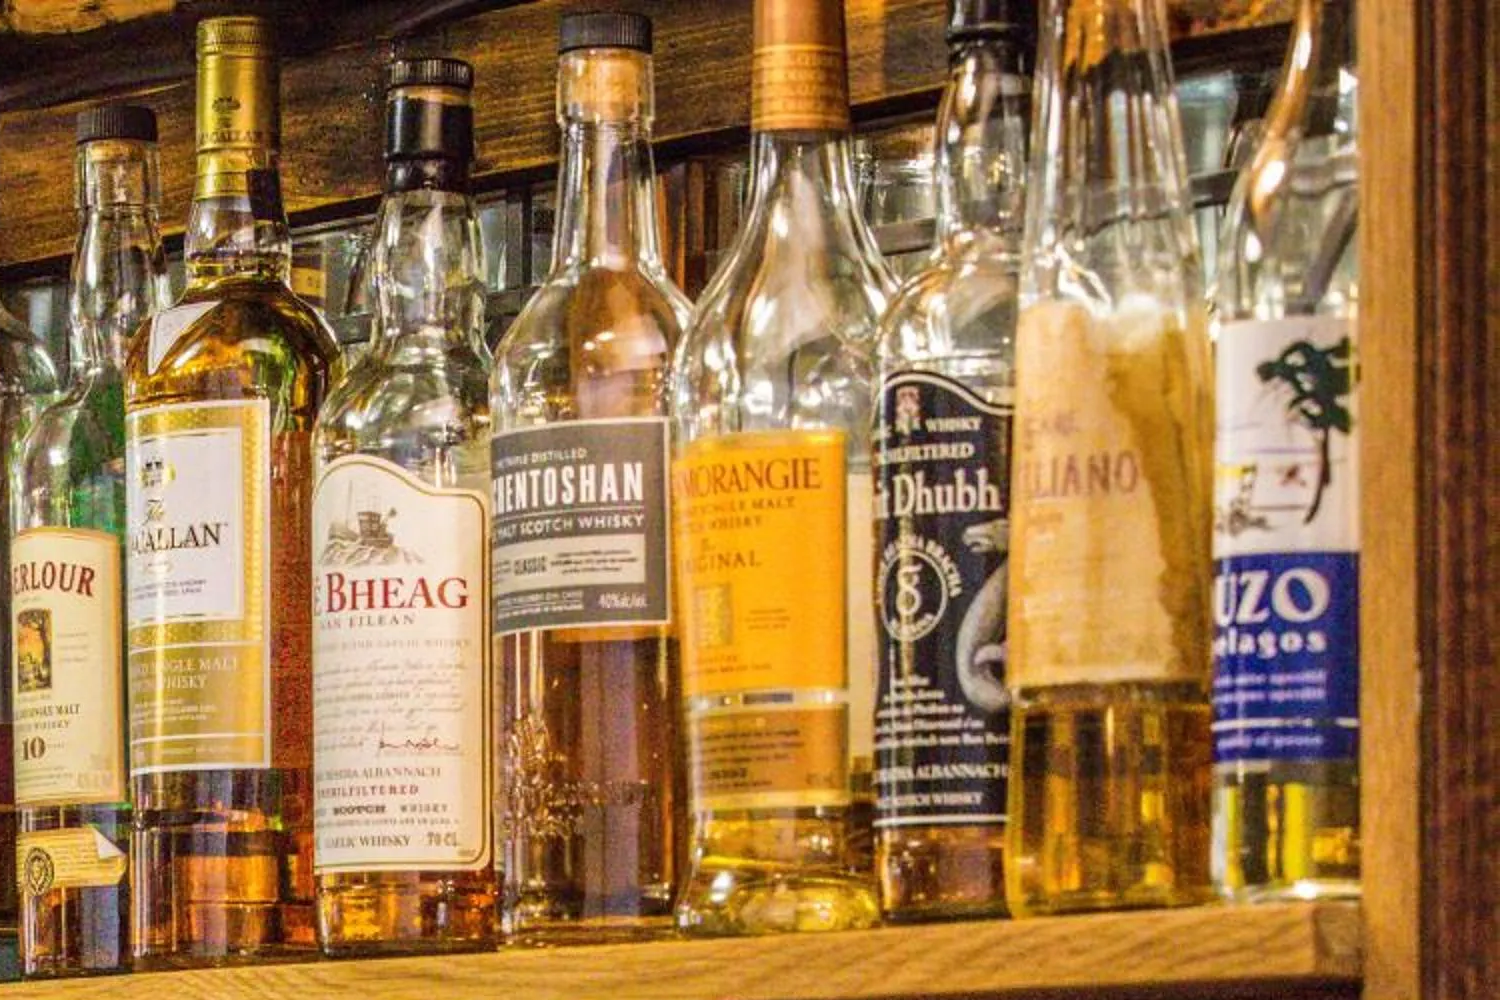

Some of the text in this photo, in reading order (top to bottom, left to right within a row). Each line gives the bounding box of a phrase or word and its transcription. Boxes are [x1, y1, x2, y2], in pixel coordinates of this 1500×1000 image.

[892, 466, 1001, 518] Dhubh
[520, 516, 574, 535] SCOTCH
[579, 513, 645, 529] WHISKY
[325, 571, 470, 613] BHEAG
[21, 735, 47, 761] 10
